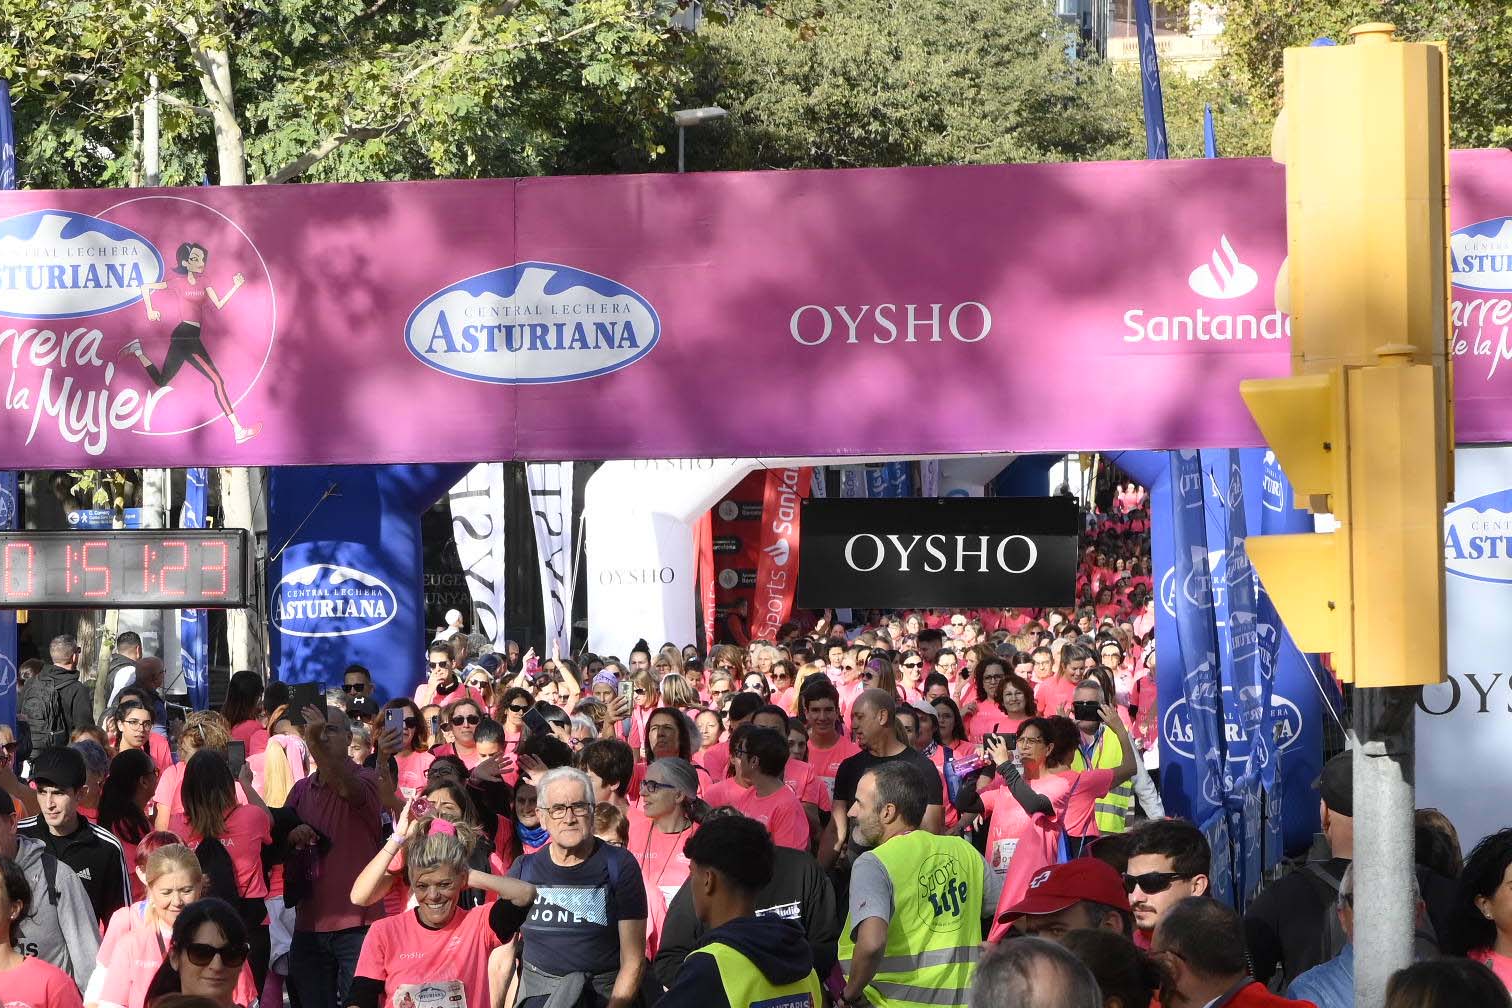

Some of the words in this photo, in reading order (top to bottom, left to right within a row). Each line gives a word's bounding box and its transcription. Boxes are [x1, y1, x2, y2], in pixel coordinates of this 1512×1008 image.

[66, 245, 139, 257] LECHERA
[464, 304, 542, 317] CENTRAL
[551, 302, 632, 316] LECHERA
[789, 301, 993, 346] OYSHO
[1122, 309, 1291, 343] Santand
[424, 310, 641, 354] ASTURIANA
[6, 371, 30, 411] la
[25, 363, 175, 455] Mujer
[772, 467, 799, 535] Santa
[844, 533, 1038, 574] OYSHO
[287, 589, 329, 597] CENTRAL
[334, 587, 383, 597] LECHERA
[598, 567, 675, 584] OYSHO
[275, 594, 388, 620] ASTURIANA
[920, 857, 957, 898] Sport
[531, 908, 597, 923] JONES
[928, 877, 968, 918] Life
